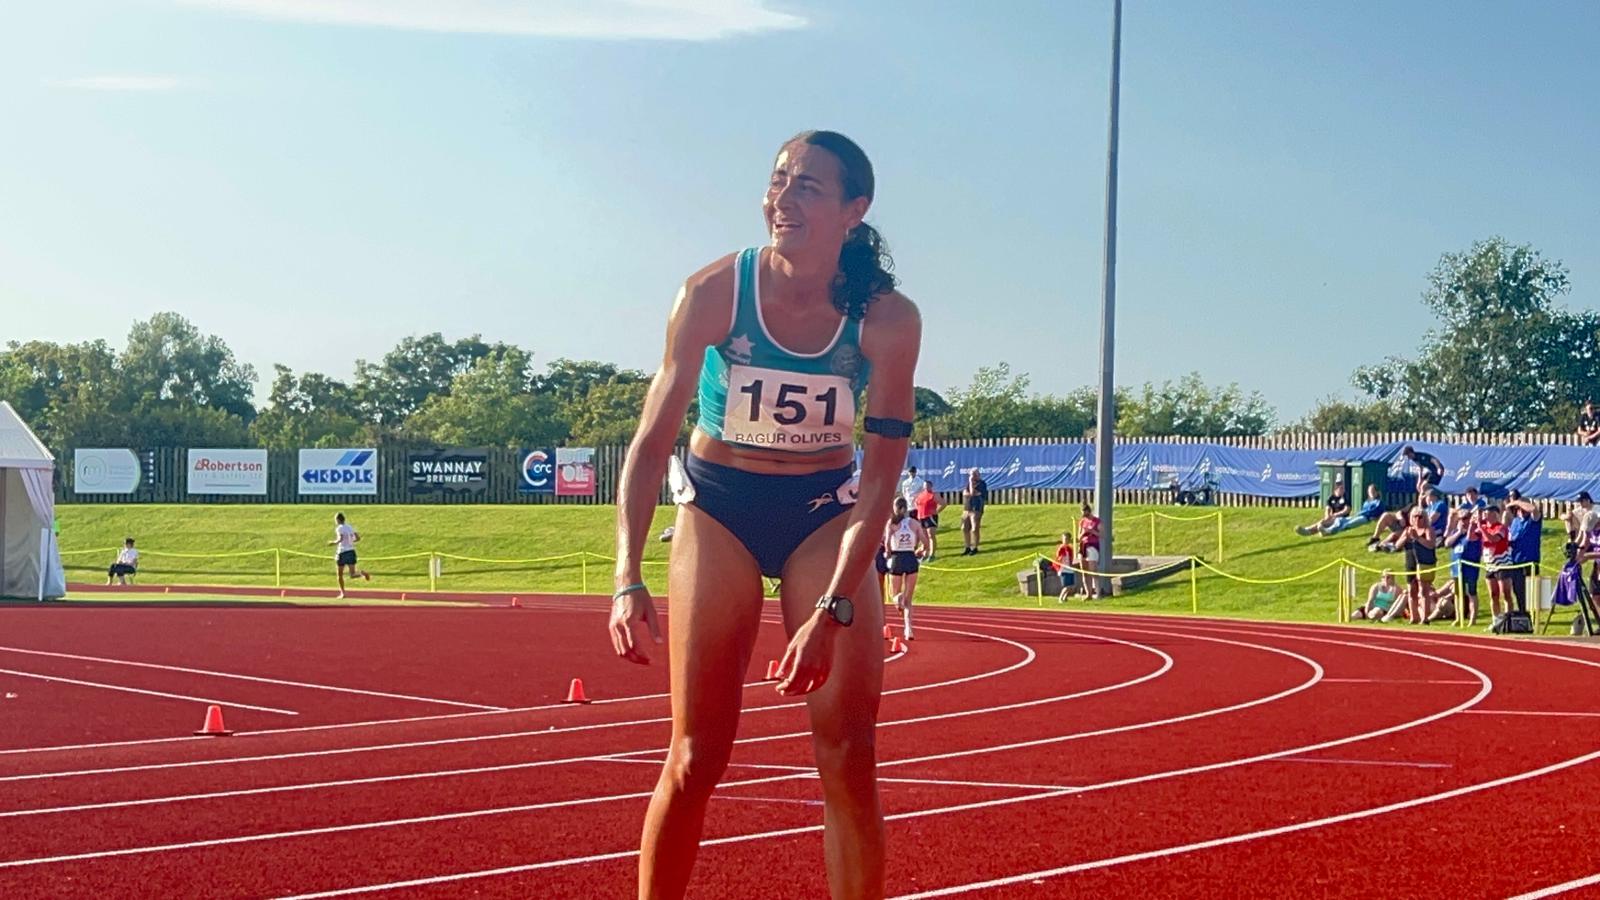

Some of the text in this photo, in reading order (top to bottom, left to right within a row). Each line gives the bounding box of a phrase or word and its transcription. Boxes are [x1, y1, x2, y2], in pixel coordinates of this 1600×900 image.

[740, 379, 838, 427] 151
[735, 432, 842, 444] BAGUR OLIVES
[201, 458, 263, 471] Robertson
[413, 461, 482, 474] SWANNAY
[302, 469, 374, 484] HEDDLE
[426, 474, 469, 483] BREWERY
[900, 533, 911, 542] 22
